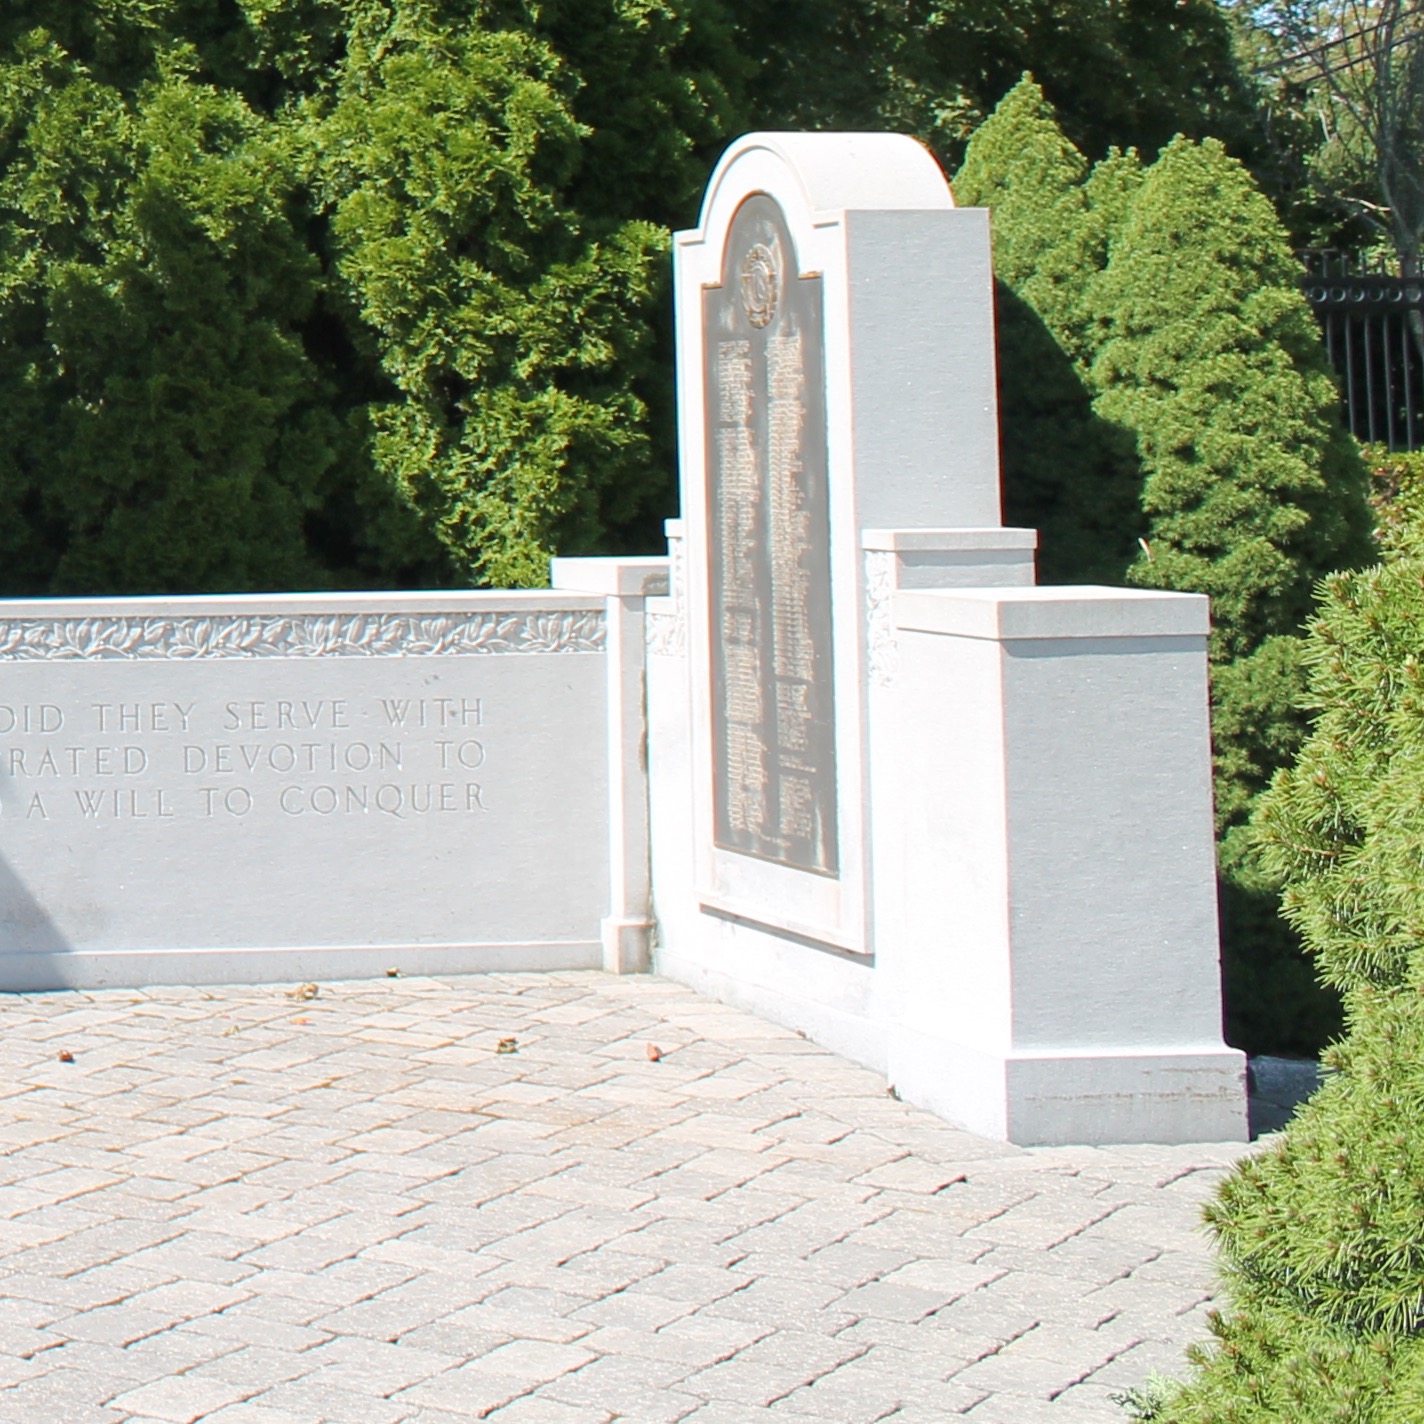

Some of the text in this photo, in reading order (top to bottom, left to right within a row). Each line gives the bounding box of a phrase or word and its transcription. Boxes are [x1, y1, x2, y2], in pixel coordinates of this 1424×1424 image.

[92, 702, 195, 733] THEY
[224, 700, 350, 730] SERVE
[380, 698, 483, 727] WITH
[183, 742, 403, 774] DEVOTION
[435, 739, 486, 770] TO
[26, 790, 50, 820] A
[75, 788, 175, 818] WILL
[200, 786, 253, 817] TO
[279, 782, 488, 819] CONQUER
